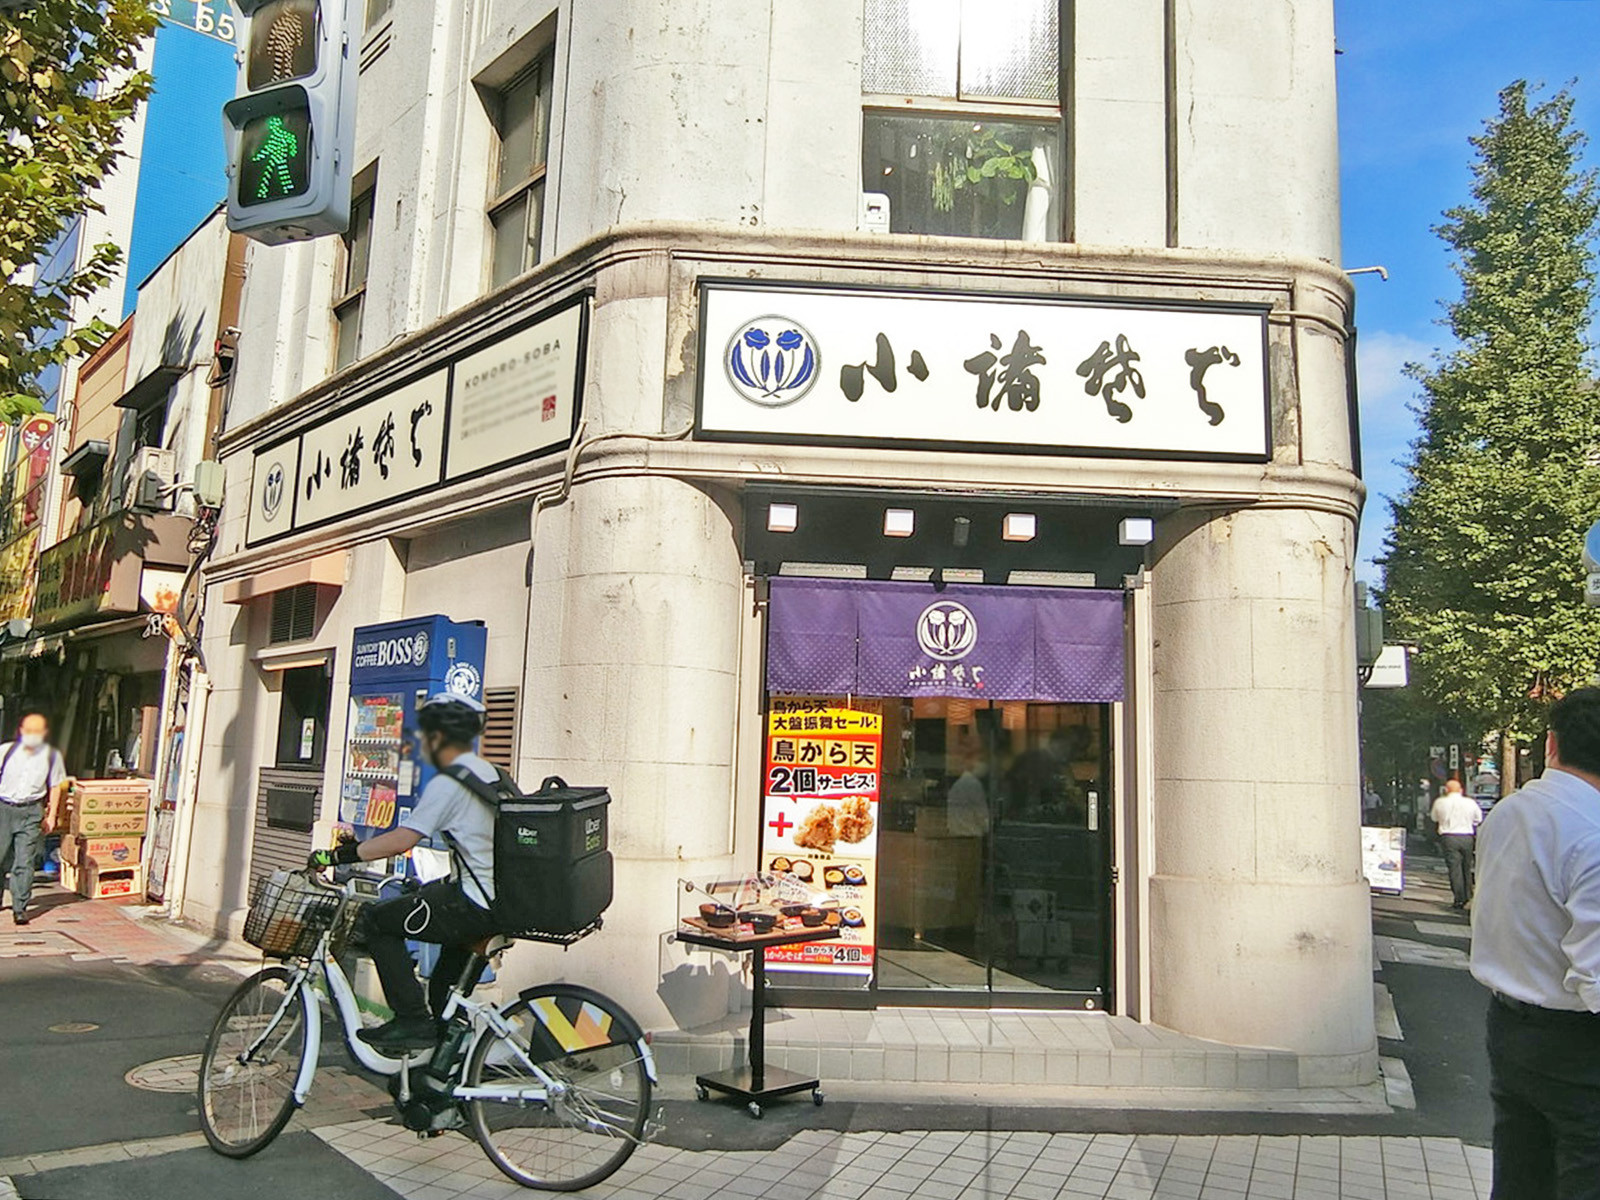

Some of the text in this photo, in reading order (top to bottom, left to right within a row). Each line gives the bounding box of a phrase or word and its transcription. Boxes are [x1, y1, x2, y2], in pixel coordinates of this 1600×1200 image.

[355, 654, 378, 667] COFFEE
[377, 637, 414, 667] BOSS
[773, 740, 876, 766] 鳥から天
[104, 799, 142, 809] キャベツ
[103, 820, 141, 830] キャベツ
[585, 819, 601, 834] Uber
[518, 827, 538, 836] Uber
